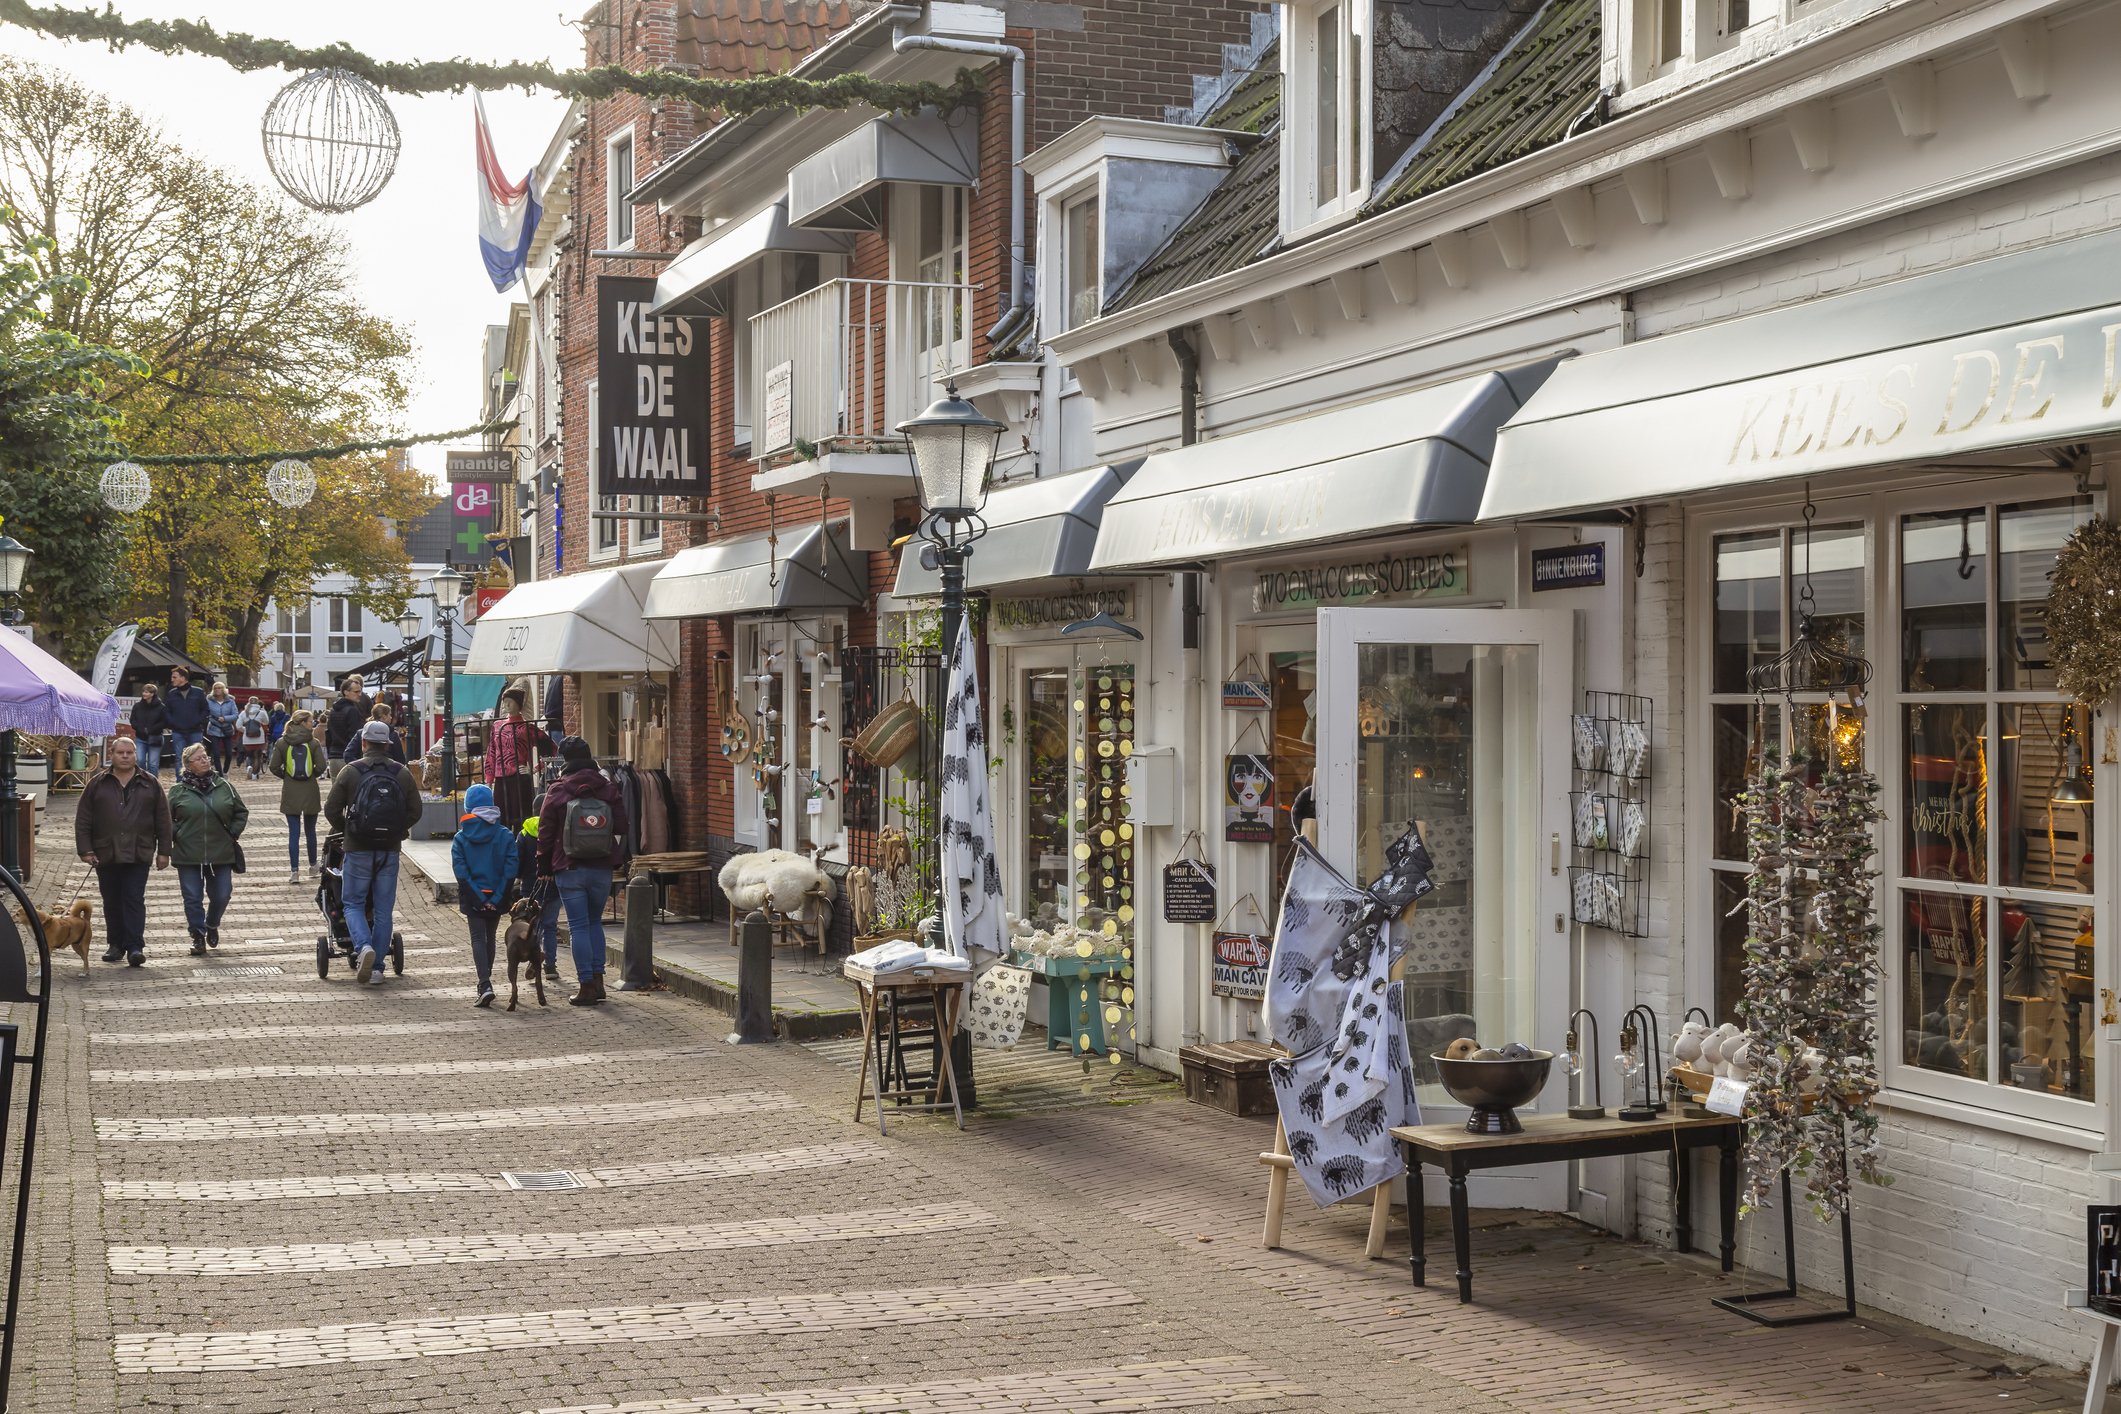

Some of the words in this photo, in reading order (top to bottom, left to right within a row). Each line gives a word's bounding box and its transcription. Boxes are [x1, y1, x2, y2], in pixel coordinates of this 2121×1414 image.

[617, 301, 693, 357] KEES
[637, 364, 675, 418] DE
[1933, 334, 2065, 437] DE
[448, 455, 511, 473] mantje
[613, 426, 697, 480] WAAL
[456, 485, 489, 512] da
[1259, 552, 1456, 605] WOONACCESSOIRES
[1536, 554, 1597, 582] BINNENBURG
[503, 625, 530, 651] ZIEZO
[1224, 684, 1244, 696] MAN
[1928, 796, 1951, 808] MERR
[1170, 867, 1188, 877] MAN
[1214, 967, 1240, 983] MAN
[1214, 985, 1230, 994] ENTER
[1237, 987, 1250, 996] YOUR
